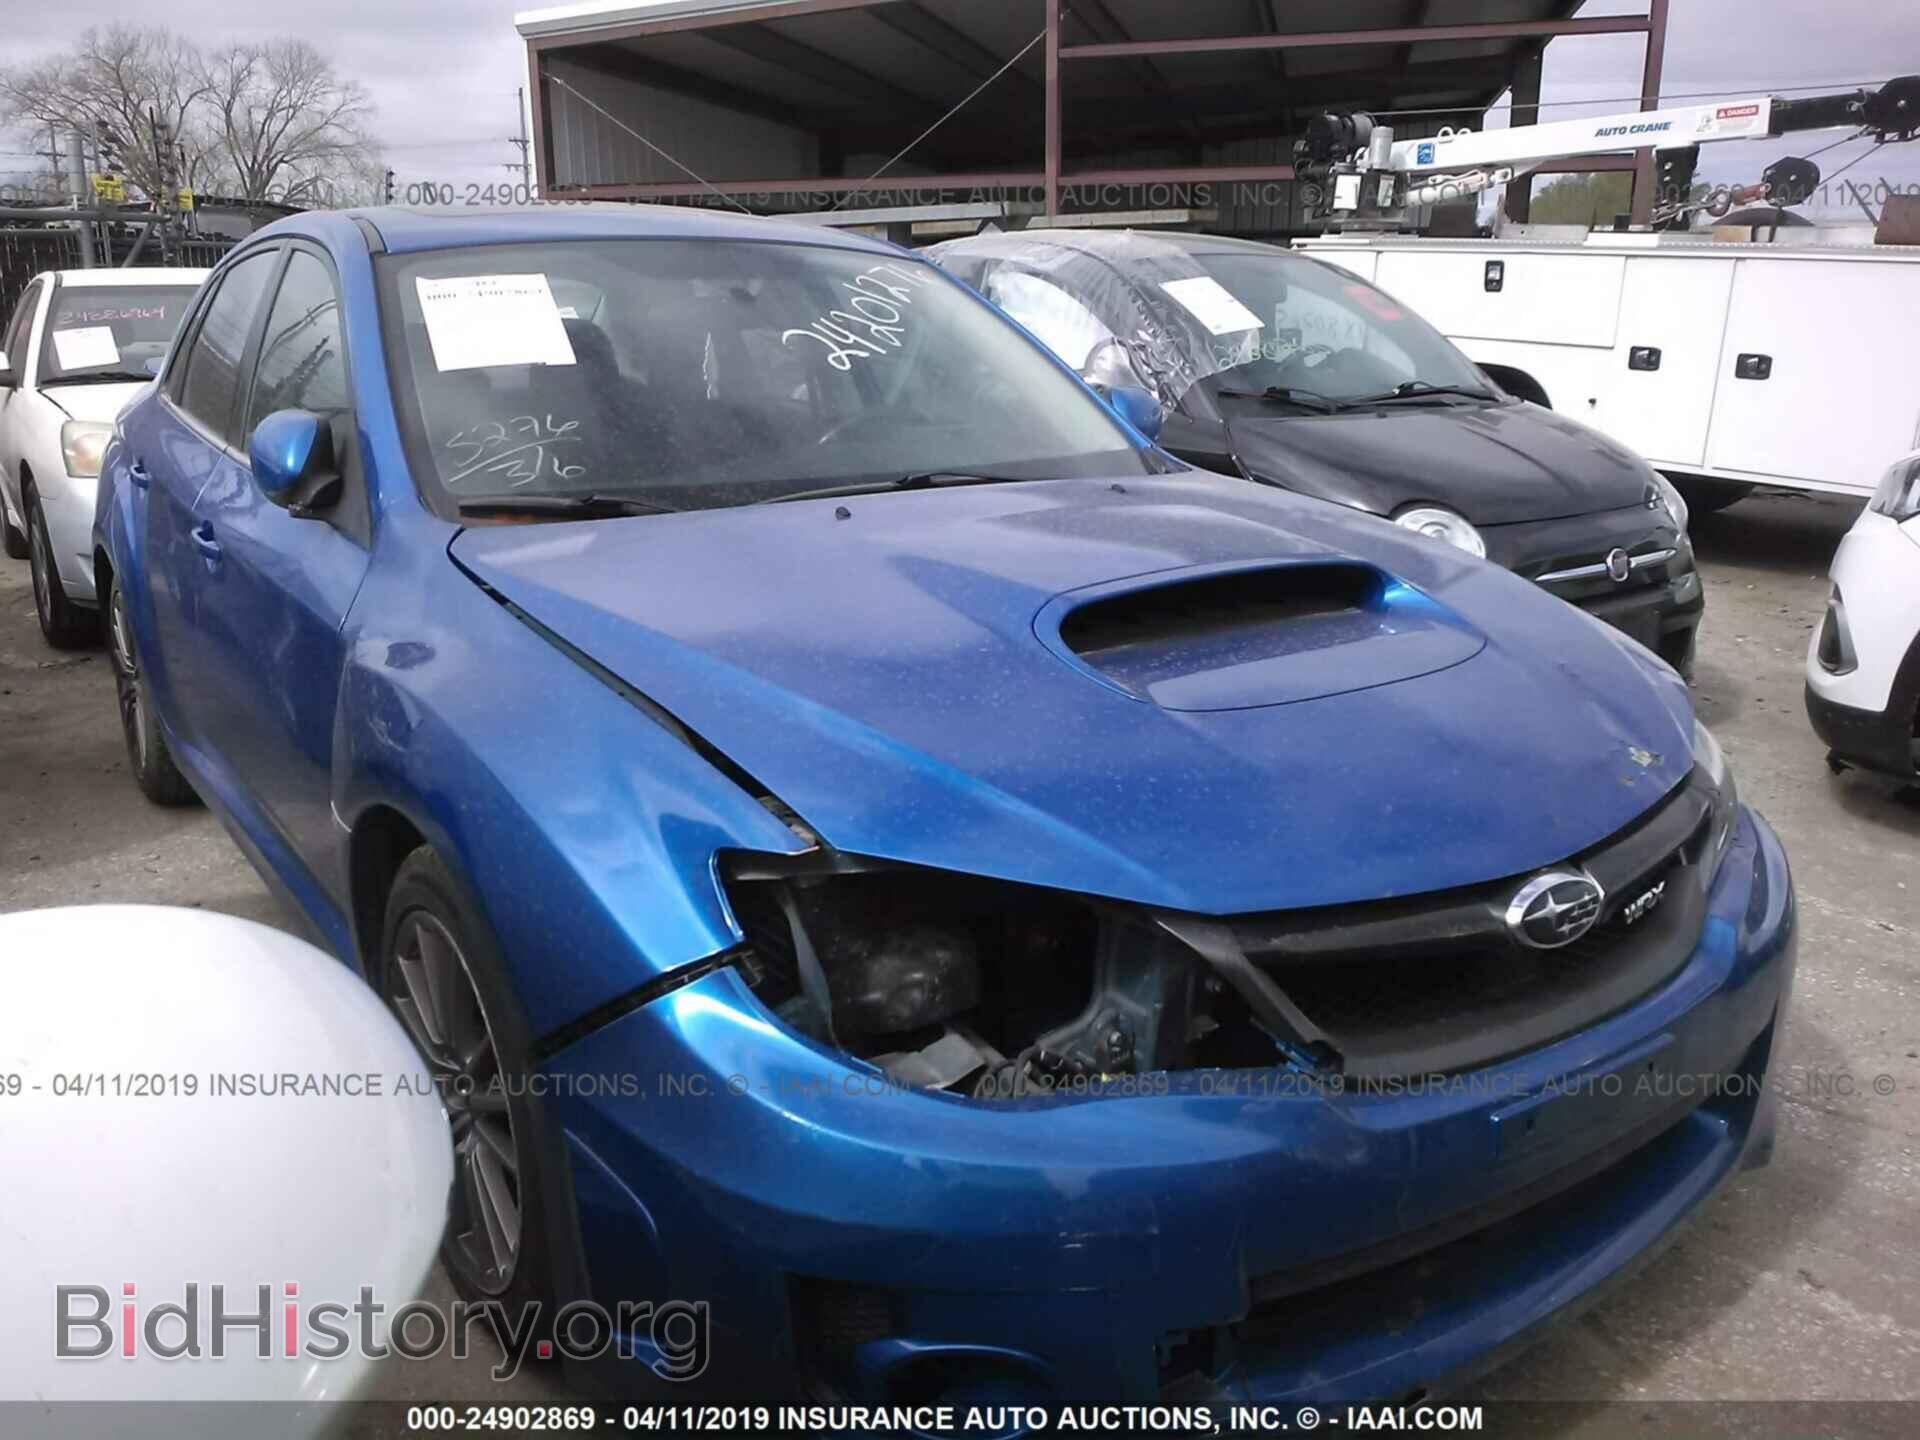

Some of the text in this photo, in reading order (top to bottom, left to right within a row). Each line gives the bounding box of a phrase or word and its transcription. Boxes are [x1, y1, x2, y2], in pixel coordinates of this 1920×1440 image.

[1594, 121, 1672, 137] AUTO CRANE
[1623, 880, 1666, 925] WRX
